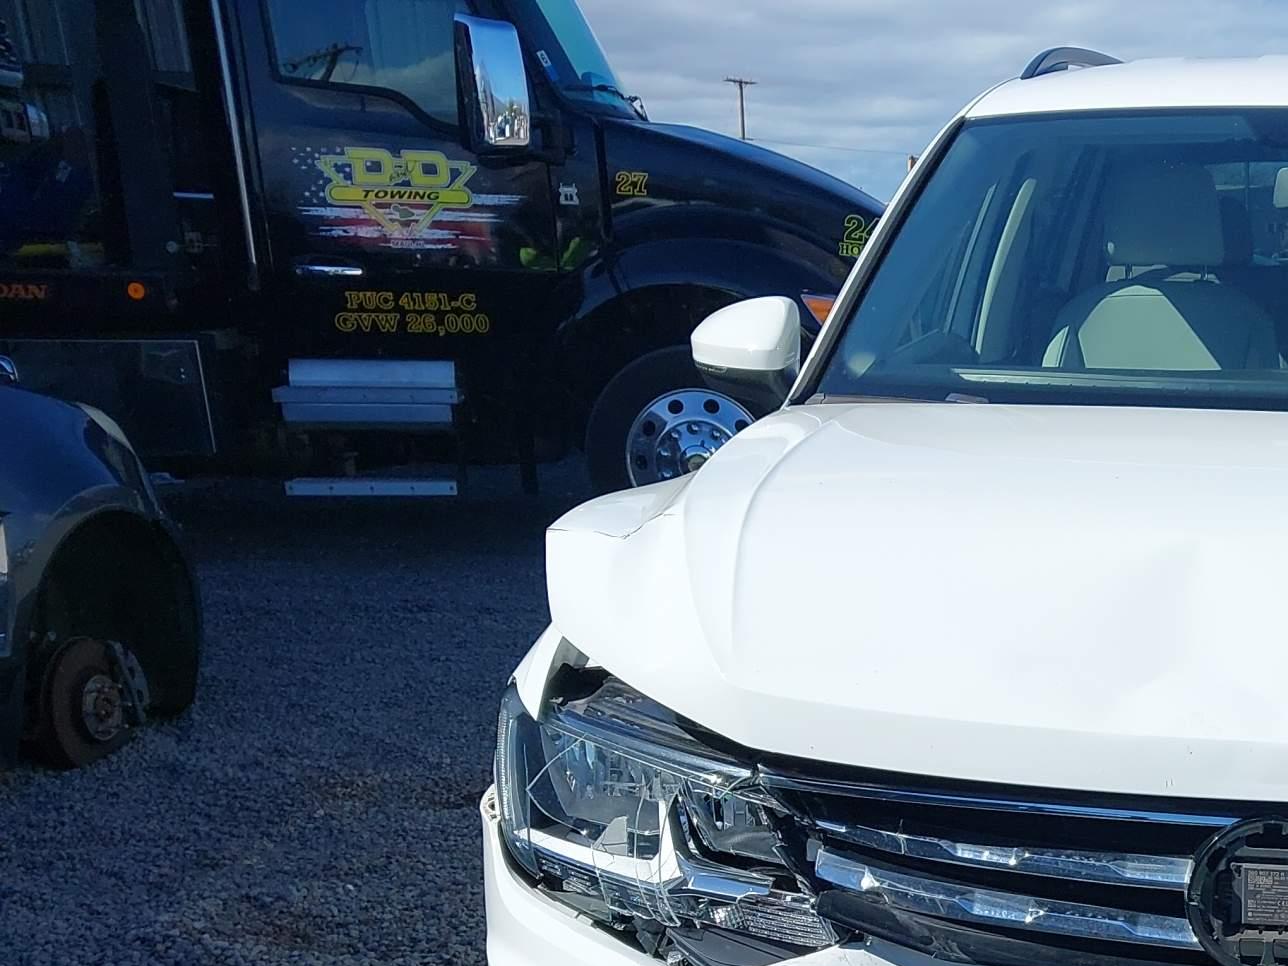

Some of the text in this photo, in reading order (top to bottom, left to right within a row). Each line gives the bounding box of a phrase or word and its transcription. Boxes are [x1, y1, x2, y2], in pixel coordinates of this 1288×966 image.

[615, 172, 649, 195] 27
[362, 189, 440, 201] TOWING
[345, 291, 477, 311] PUC 4151-C
[334, 312, 490, 336] GVW 26,000
